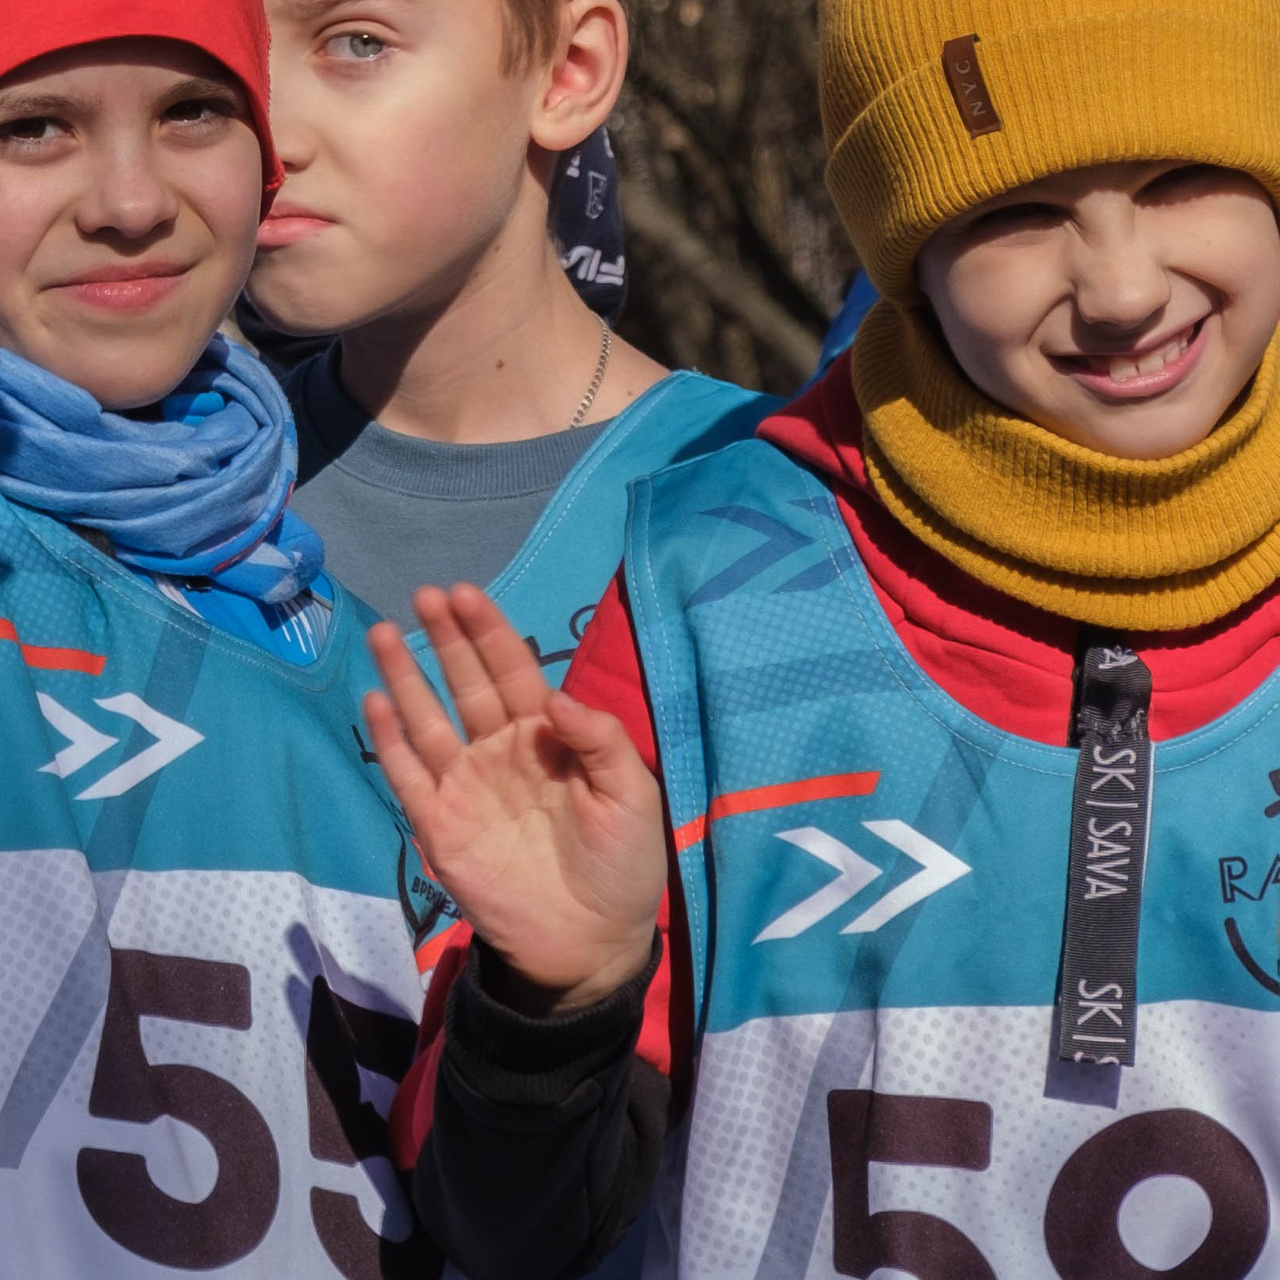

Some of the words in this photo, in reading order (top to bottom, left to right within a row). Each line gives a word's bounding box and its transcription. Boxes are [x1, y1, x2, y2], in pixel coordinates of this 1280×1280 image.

[956, 60, 986, 117] NYC
[1085, 744, 1138, 809] SKI
[1083, 817, 1132, 901] SAVA
[1072, 978, 1126, 1044] SKI
